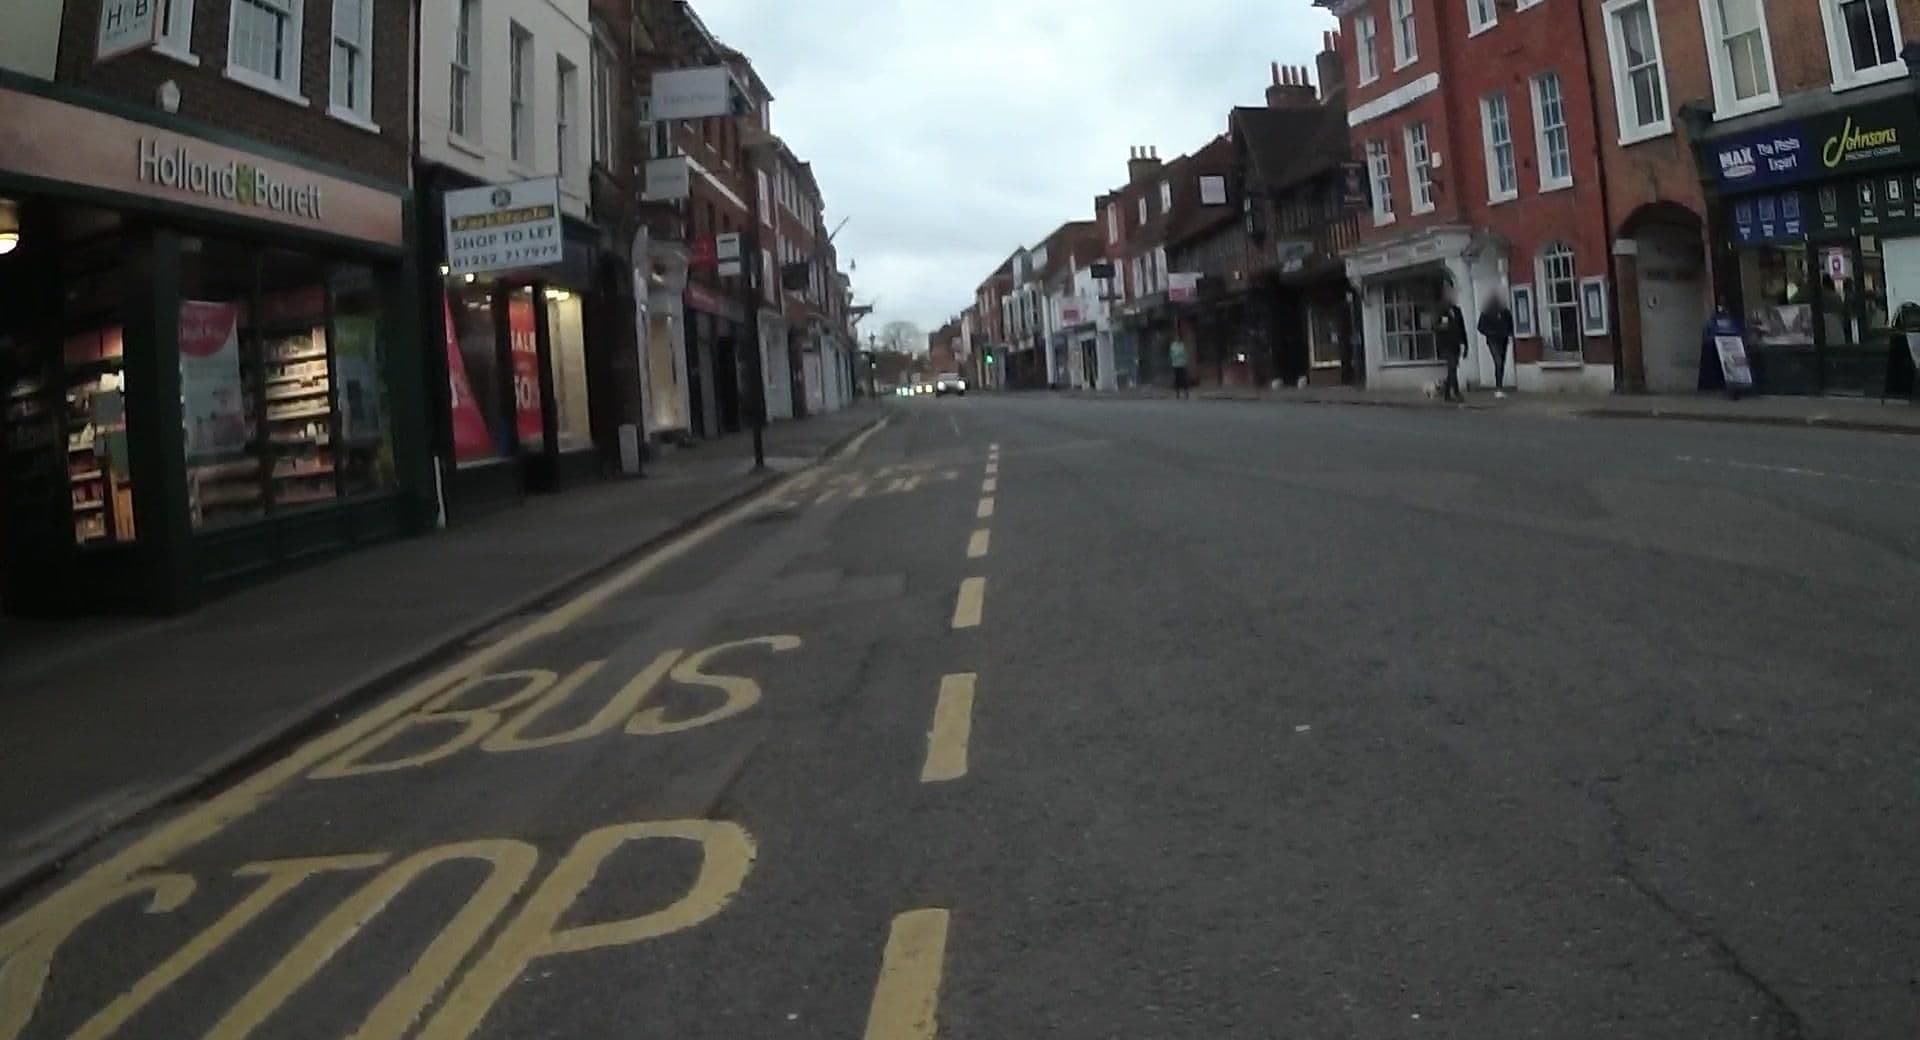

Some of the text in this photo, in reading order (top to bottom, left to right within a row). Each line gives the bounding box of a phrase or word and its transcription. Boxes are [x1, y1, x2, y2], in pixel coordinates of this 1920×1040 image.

[1719, 147, 1753, 168] MAX
[1823, 117, 1897, 168] Johnsons
[138, 136, 237, 199] Holland
[251, 166, 321, 219] Barrett
[454, 226, 553, 250] SHOP TO LET
[307, 634, 801, 780] BUS
